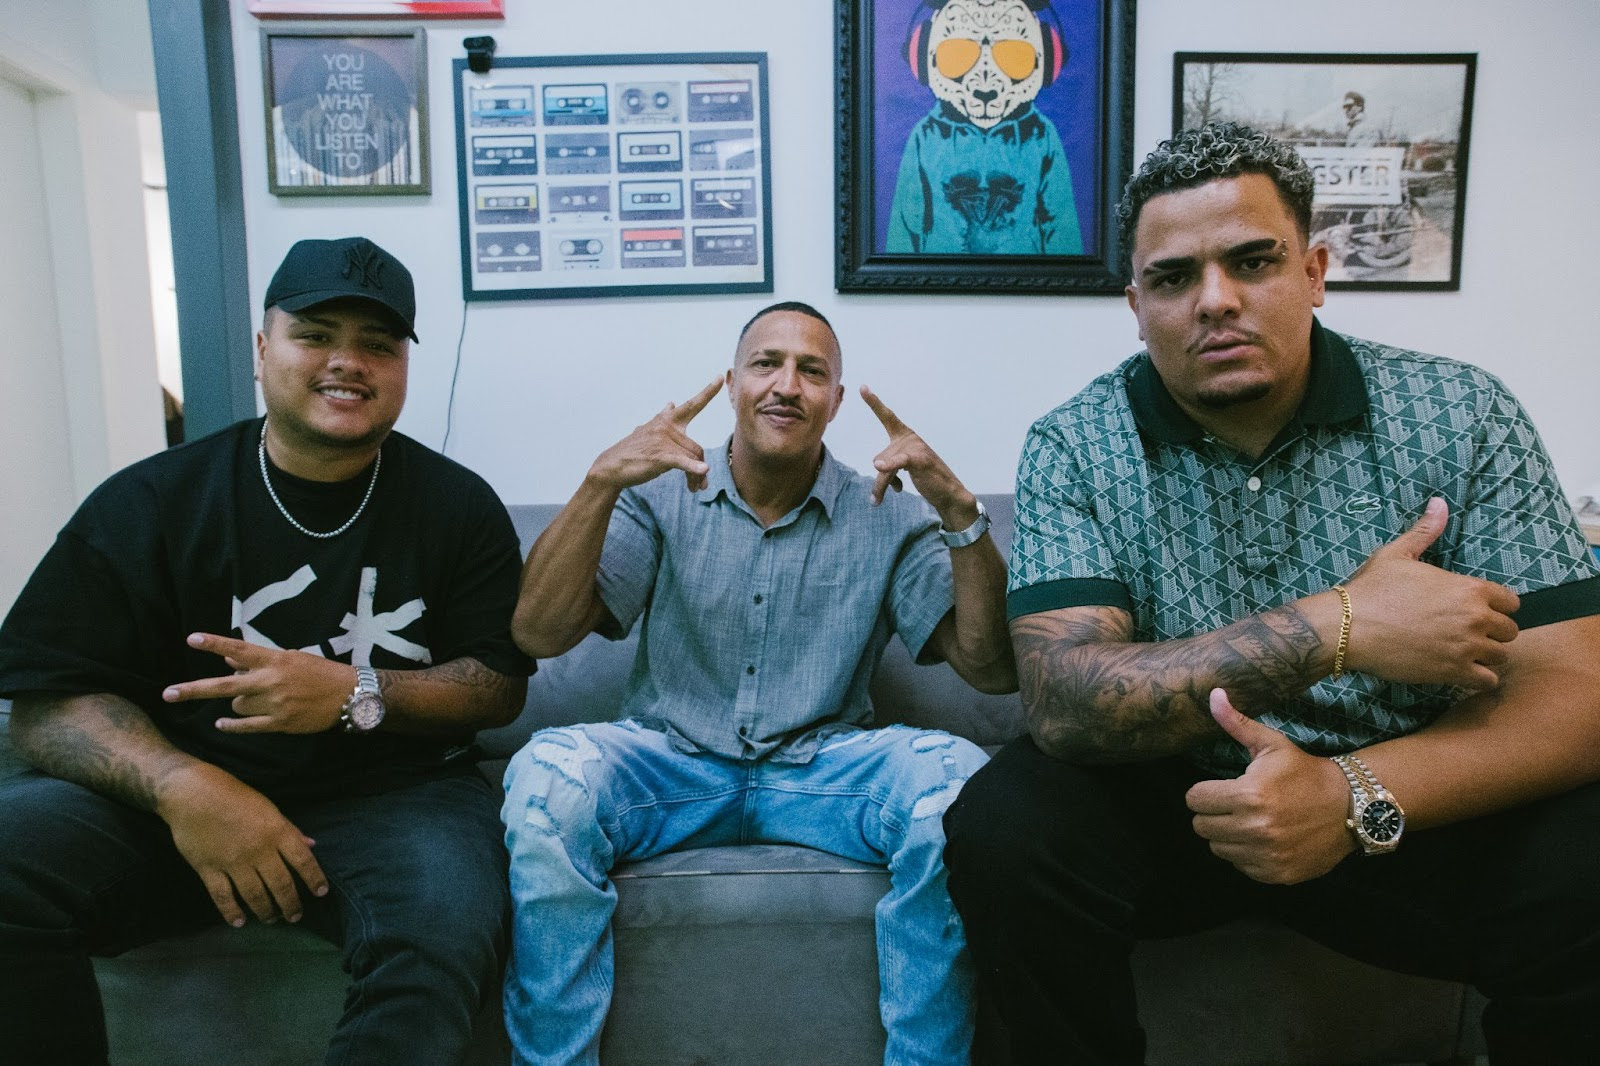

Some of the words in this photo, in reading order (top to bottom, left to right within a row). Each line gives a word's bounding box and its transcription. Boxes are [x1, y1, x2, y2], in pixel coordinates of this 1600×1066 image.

[322, 53, 365, 72] YOU
[325, 73, 365, 92] ARE
[316, 92, 374, 111] WHAT
[325, 112, 368, 132] YOU
[314, 132, 379, 151] LISTEN
[334, 152, 361, 171] TO
